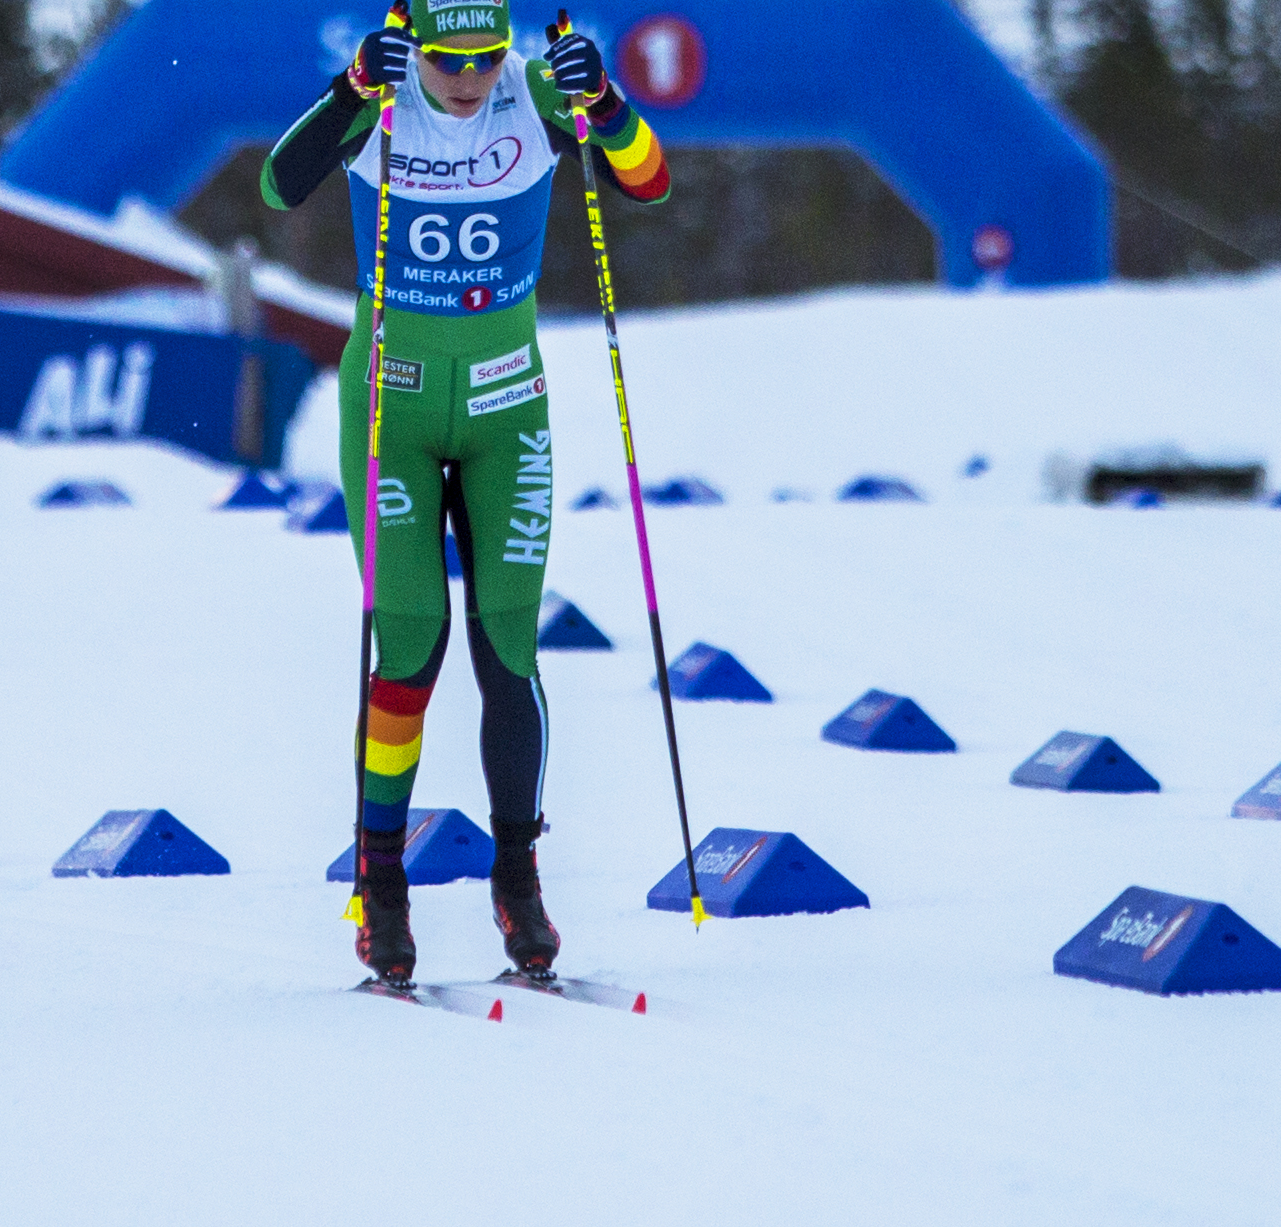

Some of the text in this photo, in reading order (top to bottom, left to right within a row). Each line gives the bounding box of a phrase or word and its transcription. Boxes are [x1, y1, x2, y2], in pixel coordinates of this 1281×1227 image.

[436, 9, 495, 33] HEMING
[636, 23, 684, 100] 1
[389, 150, 501, 177] sport 1
[389, 175, 416, 188] kte
[408, 213, 500, 263] 66
[403, 266, 503, 284] MERÅKER
[366, 273, 459, 308] SareBank
[469, 289, 484, 308] 1
[497, 271, 534, 303] SMN
[382, 373, 414, 386] RØNN
[383, 360, 416, 375] ESTER
[477, 354, 527, 381] Scandic
[471, 385, 533, 413] SpareBank
[503, 429, 551, 565] HEMING
